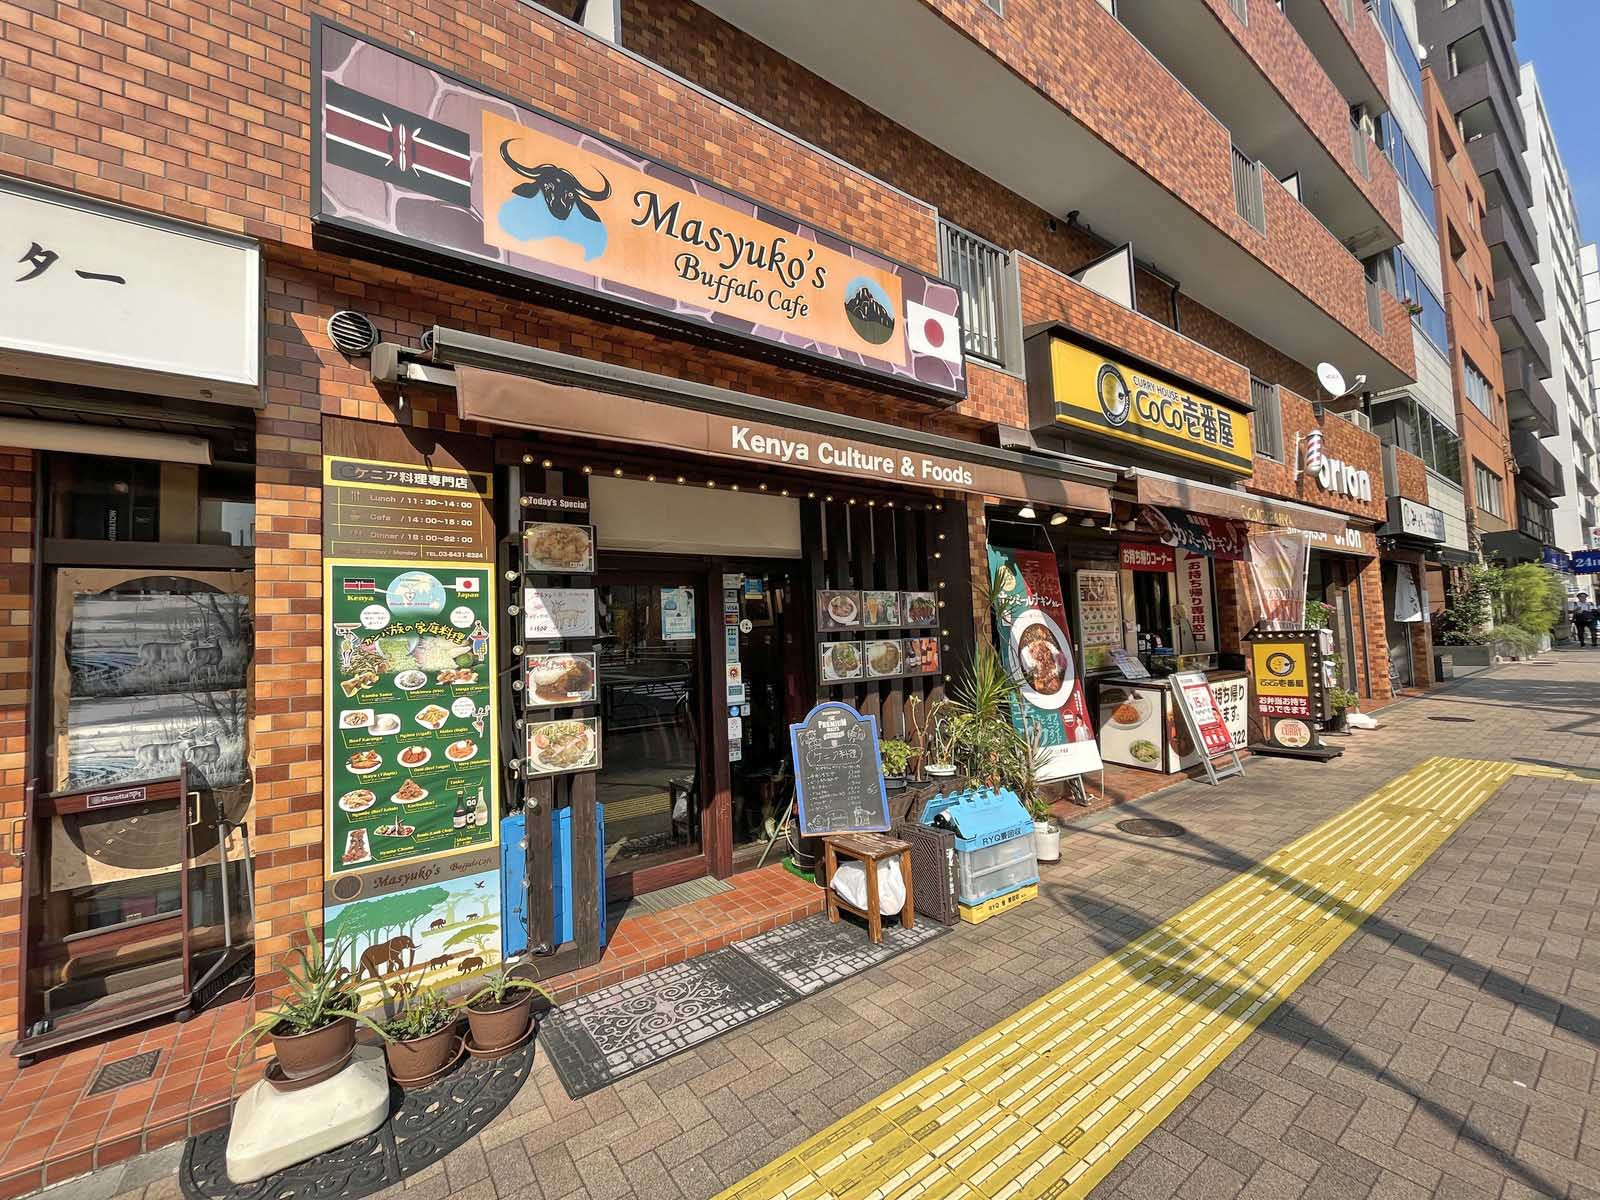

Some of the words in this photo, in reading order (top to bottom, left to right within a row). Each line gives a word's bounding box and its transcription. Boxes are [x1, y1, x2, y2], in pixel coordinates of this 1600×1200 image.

[631, 190, 828, 289] Masyuko's
[16, 241, 126, 285] ター
[675, 253, 764, 304] Buffalo
[768, 290, 810, 320] Cafe
[1133, 376, 1155, 392] CURRY
[1157, 385, 1179, 401] HOUSE
[1136, 390, 1234, 448] CoCo壱番屋
[731, 426, 809, 462] Kenya
[818, 442, 894, 474] Culture
[901, 456, 915, 477] &
[922, 460, 972, 485] Foods
[354, 467, 468, 490] ケニア料理専門店
[370, 495, 396, 504] Lunch
[529, 496, 557, 507] Today's
[560, 499, 587, 509] Special
[370, 532, 398, 541] Dinner
[347, 595, 374, 603] Kenya
[1259, 696, 1307, 706] お弁当お持ち
[1259, 704, 1310, 716] 帰りできます。
[374, 863, 441, 889] Masyuko's
